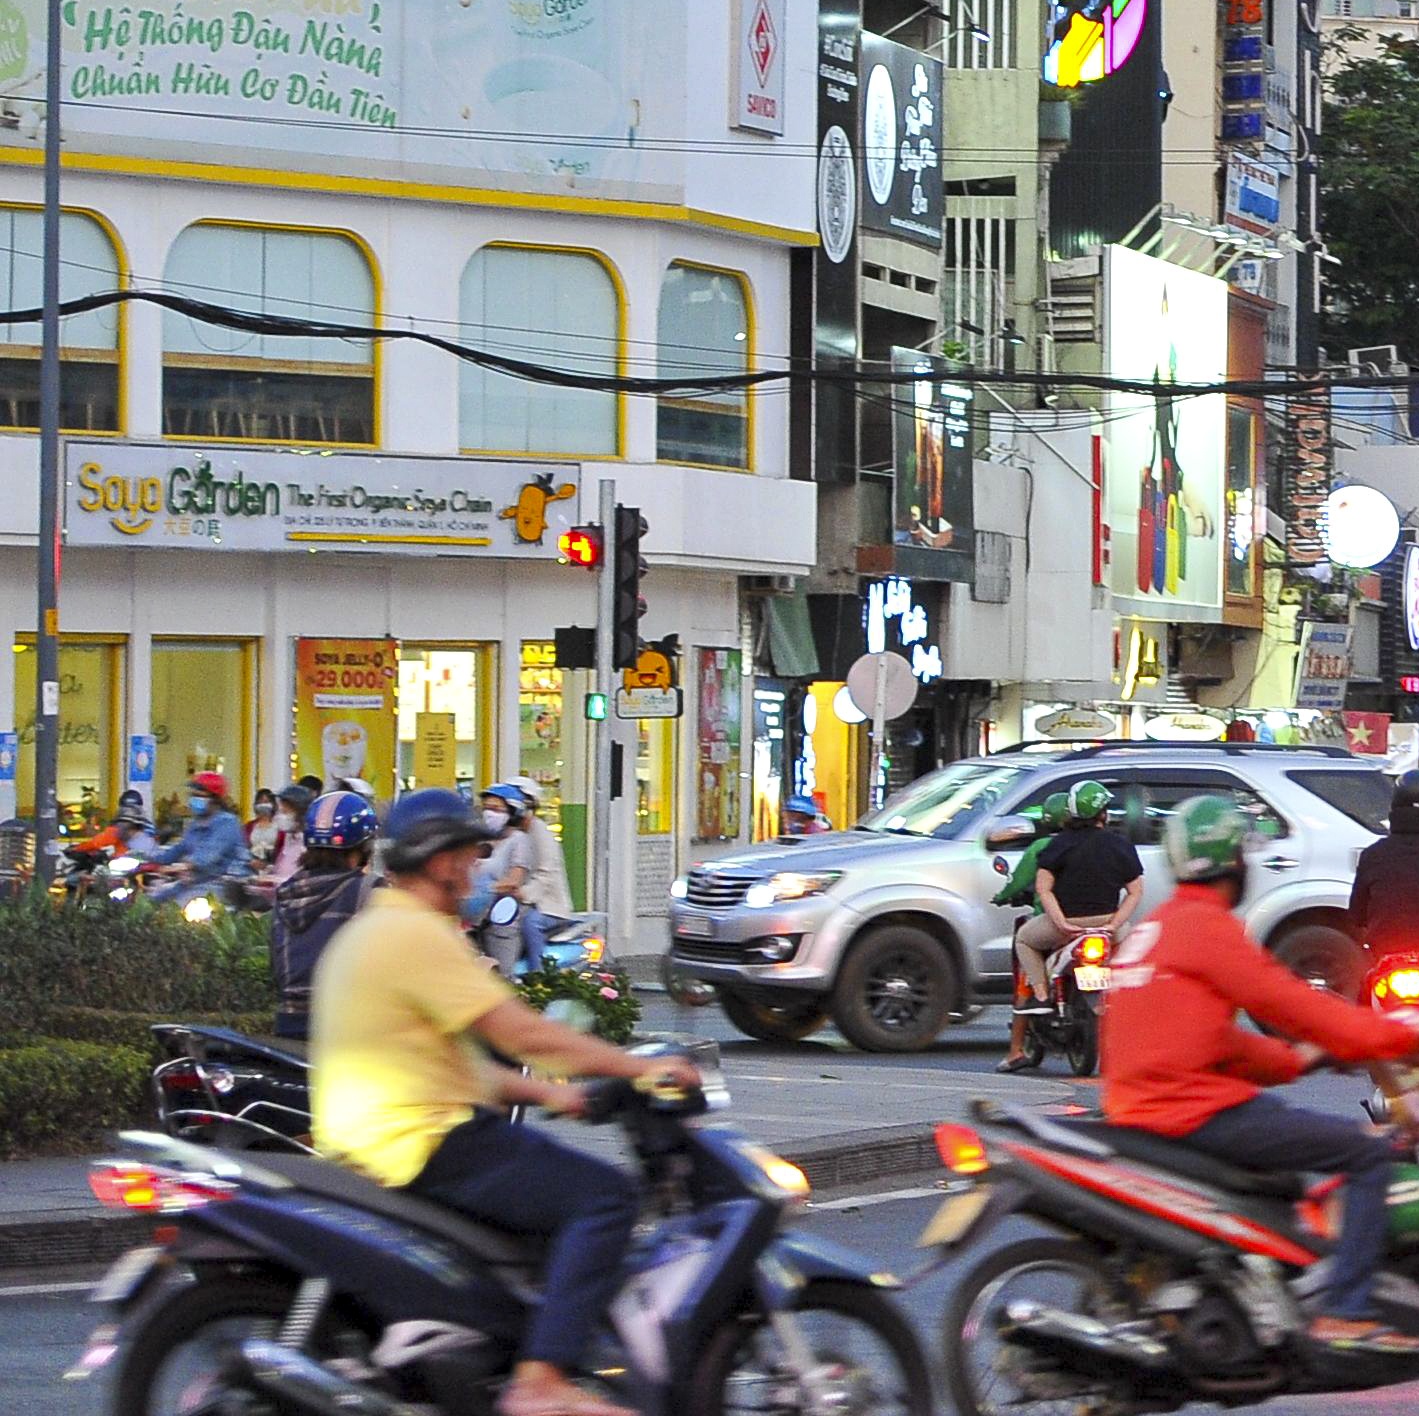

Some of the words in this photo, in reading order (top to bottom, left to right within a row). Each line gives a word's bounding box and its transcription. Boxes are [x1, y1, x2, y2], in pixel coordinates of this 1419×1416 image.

[84, 6, 131, 61] Hệ
[138, 2, 224, 52] Thống
[230, 10, 291, 62] Đậu
[299, 19, 384, 78] Nành
[70, 51, 162, 101] Chuẩn
[171, 62, 230, 97] Hữu
[240, 67, 279, 102] Cơ
[286, 70, 342, 115] Đầu
[349, 94, 397, 130] Tiên
[78, 461, 164, 522] Soya
[167, 462, 280, 516] Garden
